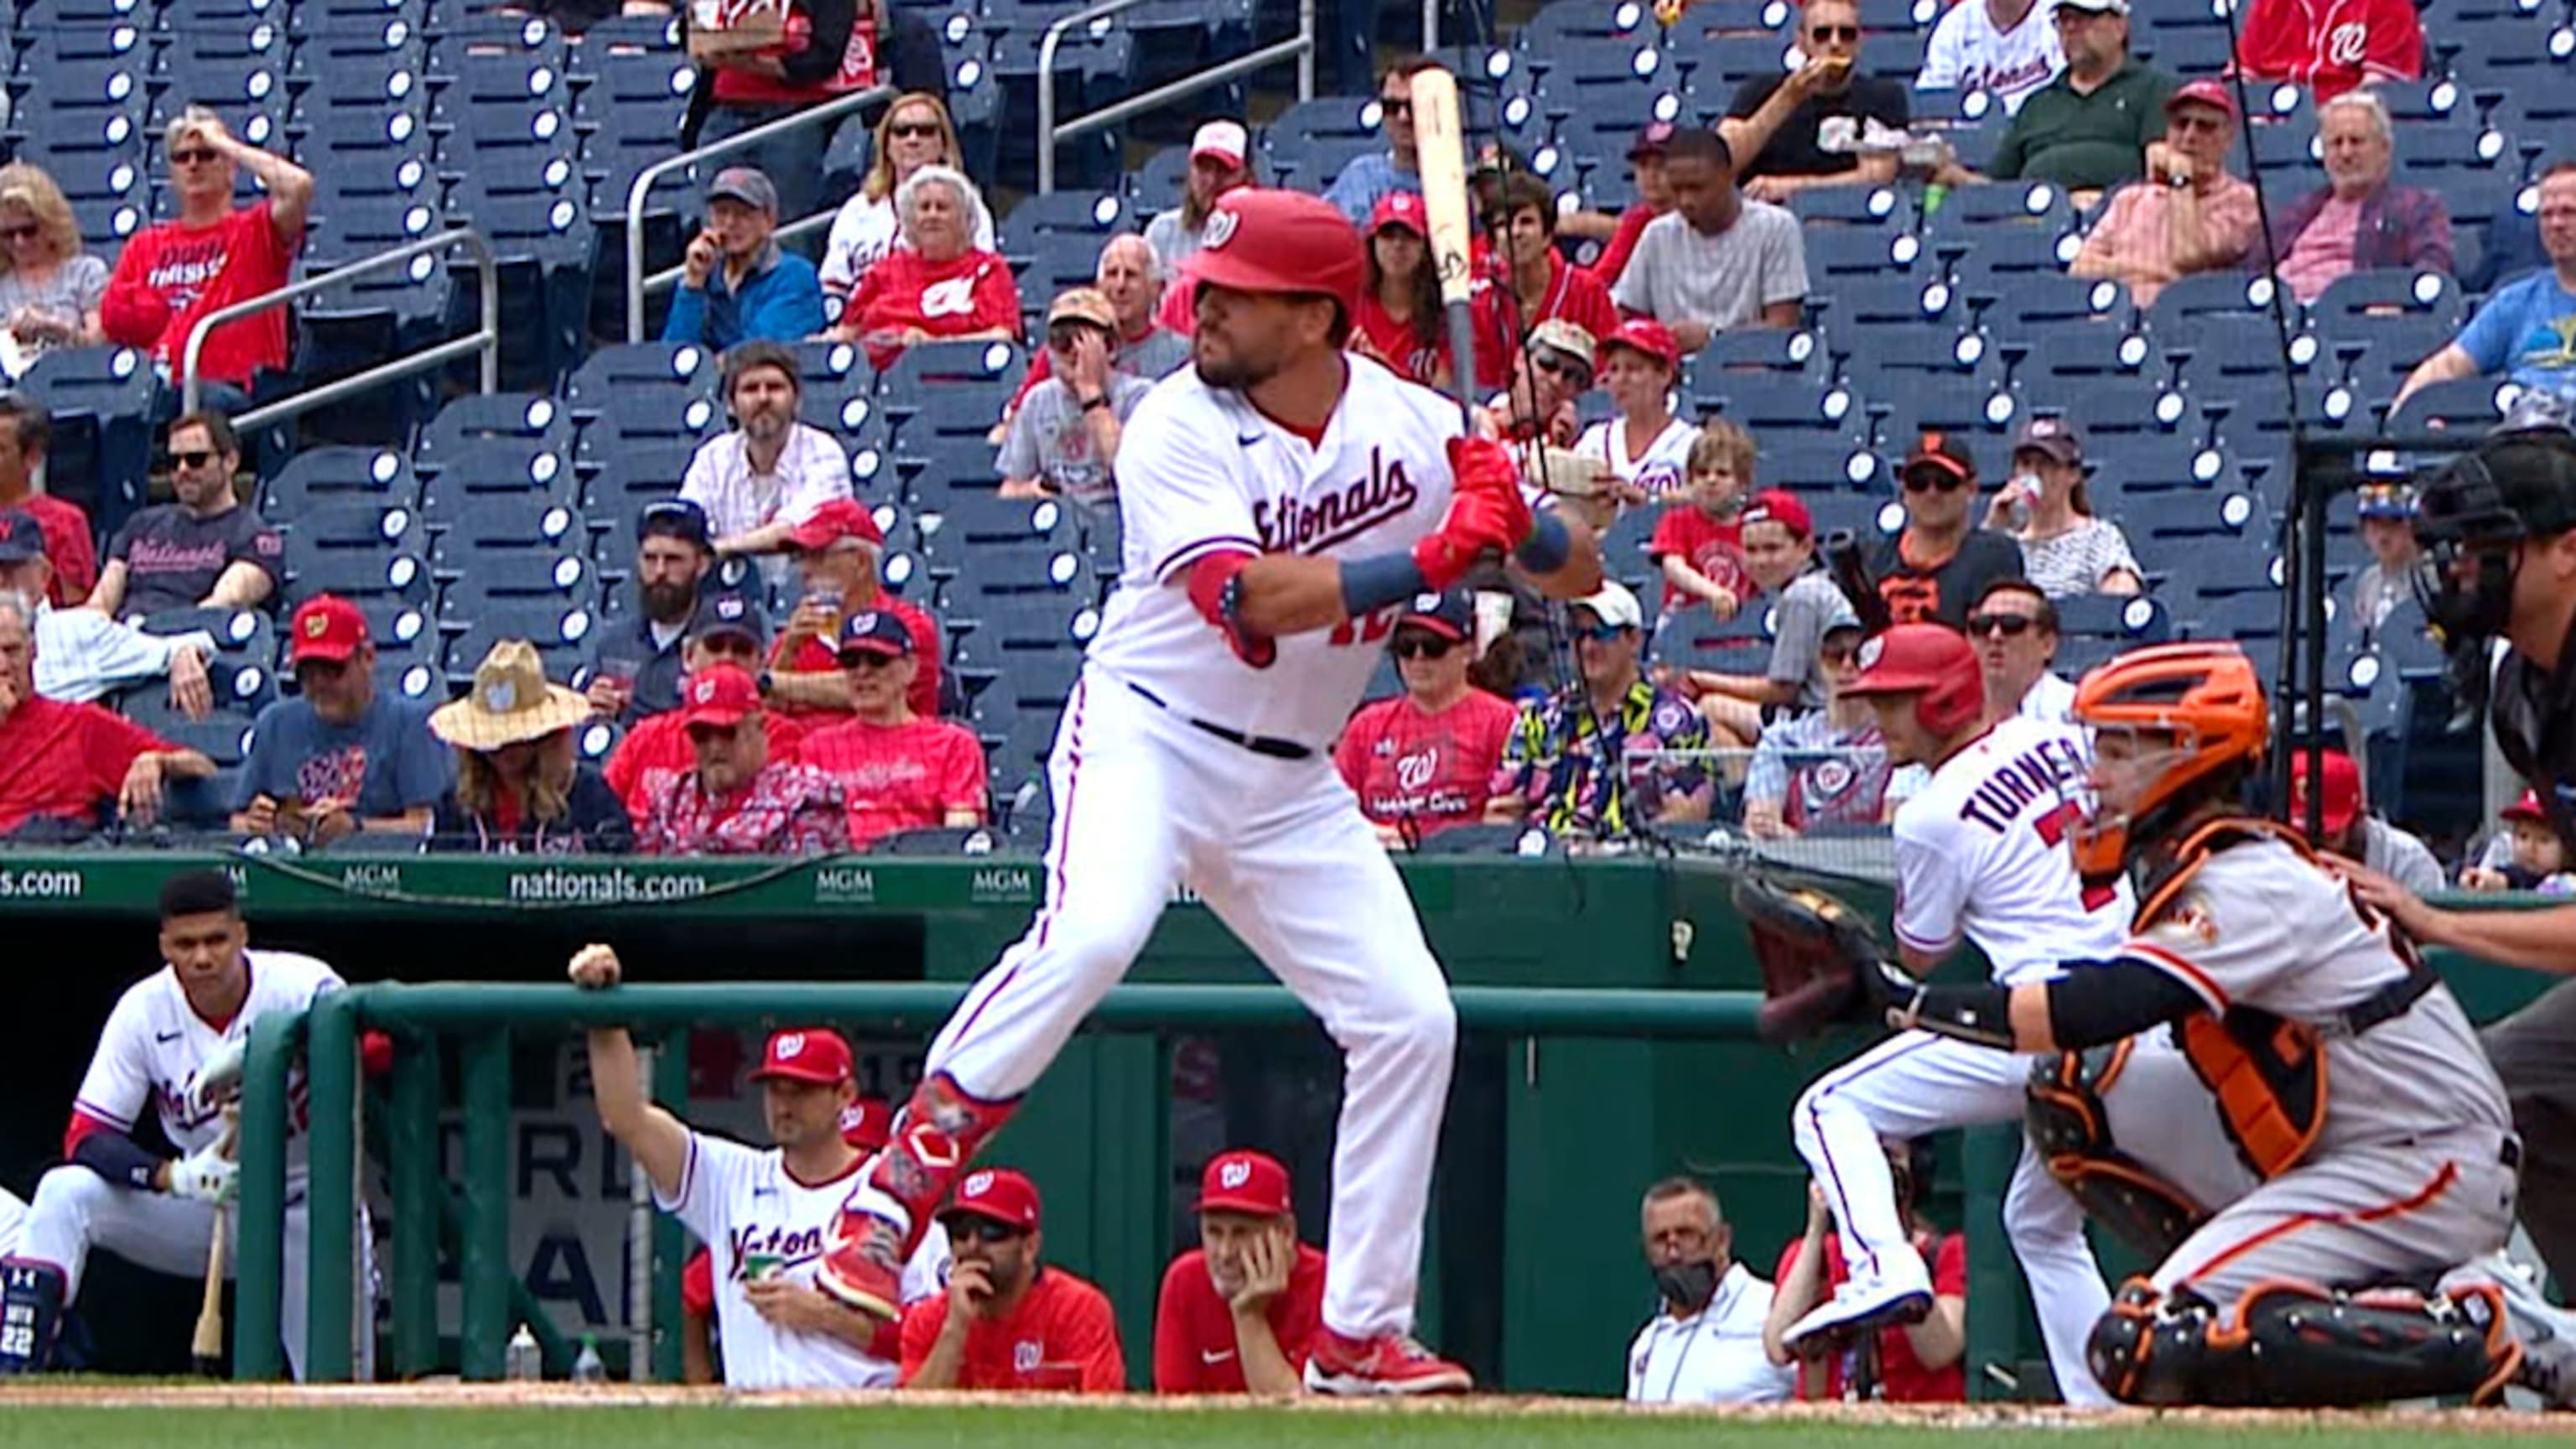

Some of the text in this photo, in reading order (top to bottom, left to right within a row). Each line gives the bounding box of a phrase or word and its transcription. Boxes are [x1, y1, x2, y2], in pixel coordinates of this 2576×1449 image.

[1254, 444, 1417, 555] tionals
[1397, 746, 1438, 791] W
[1960, 735, 2085, 835] TURNER
[510, 866, 706, 901] nationals.com
[816, 868, 875, 892] MGM
[973, 869, 1031, 892] MGM
[1, 1324, 34, 1358] 22
